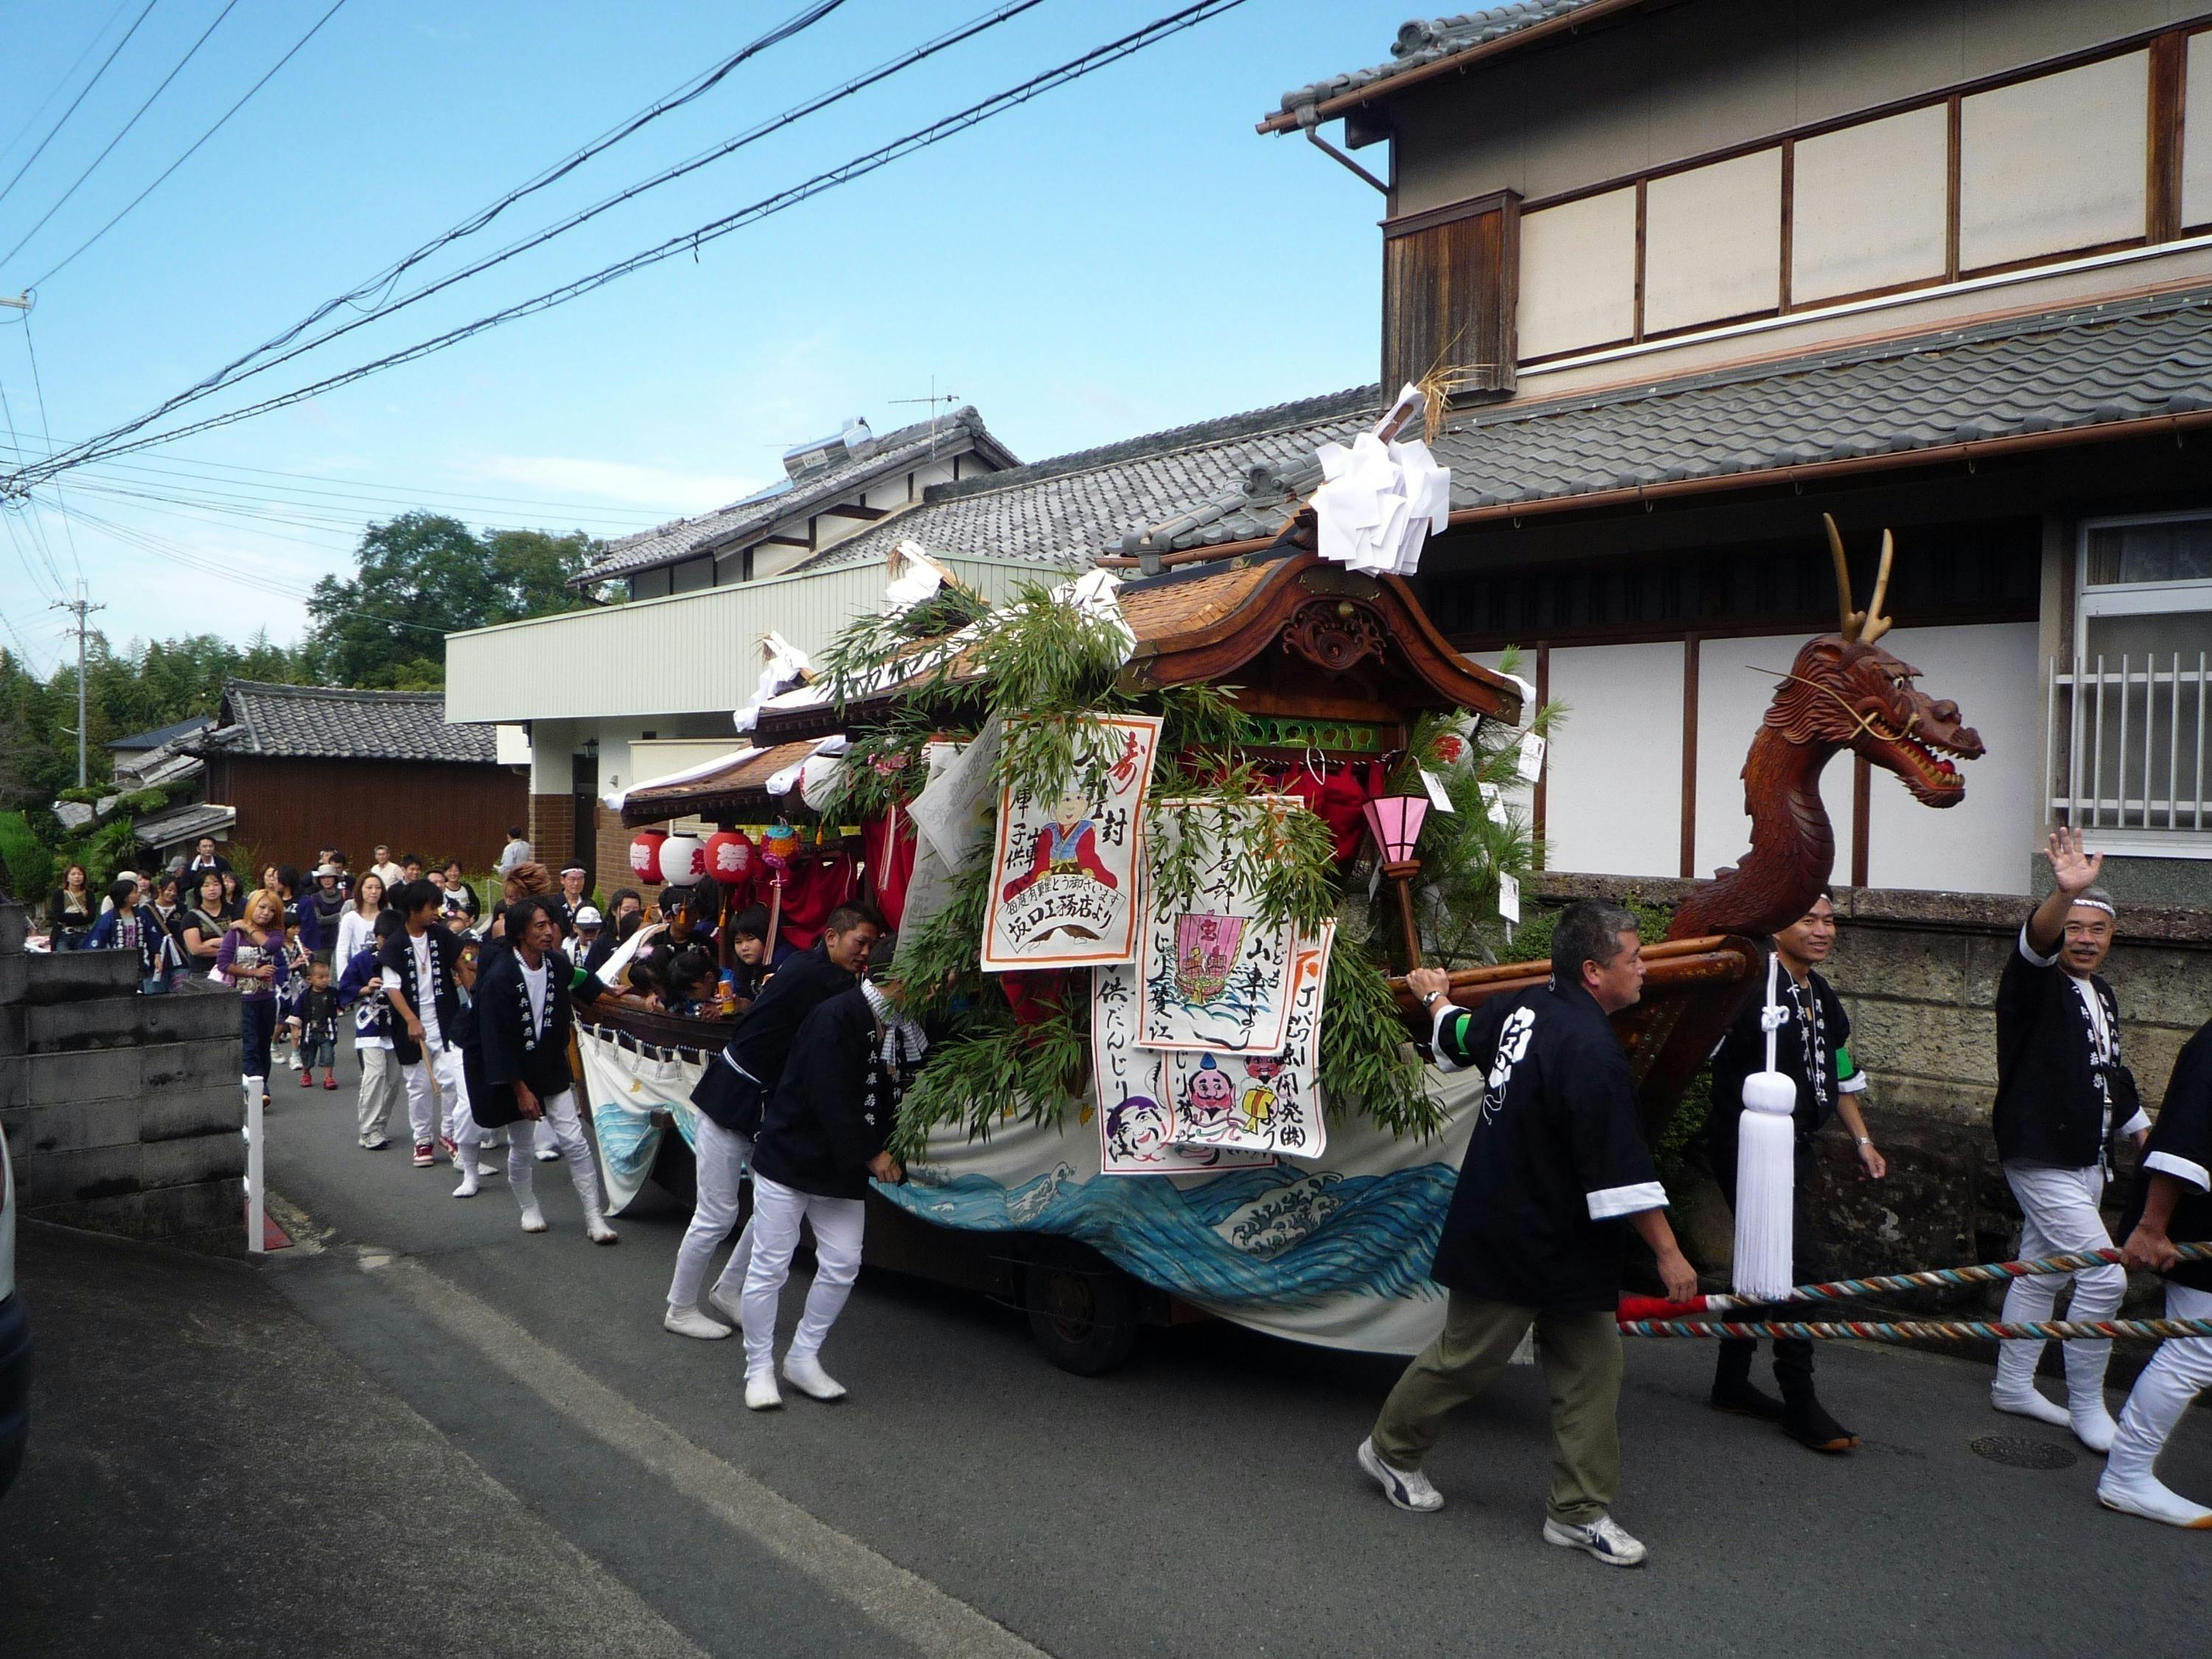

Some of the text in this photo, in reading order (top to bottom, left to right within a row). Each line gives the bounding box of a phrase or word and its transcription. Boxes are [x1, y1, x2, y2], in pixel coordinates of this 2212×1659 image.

[1009, 894, 1113, 943] 坂口工務店より
